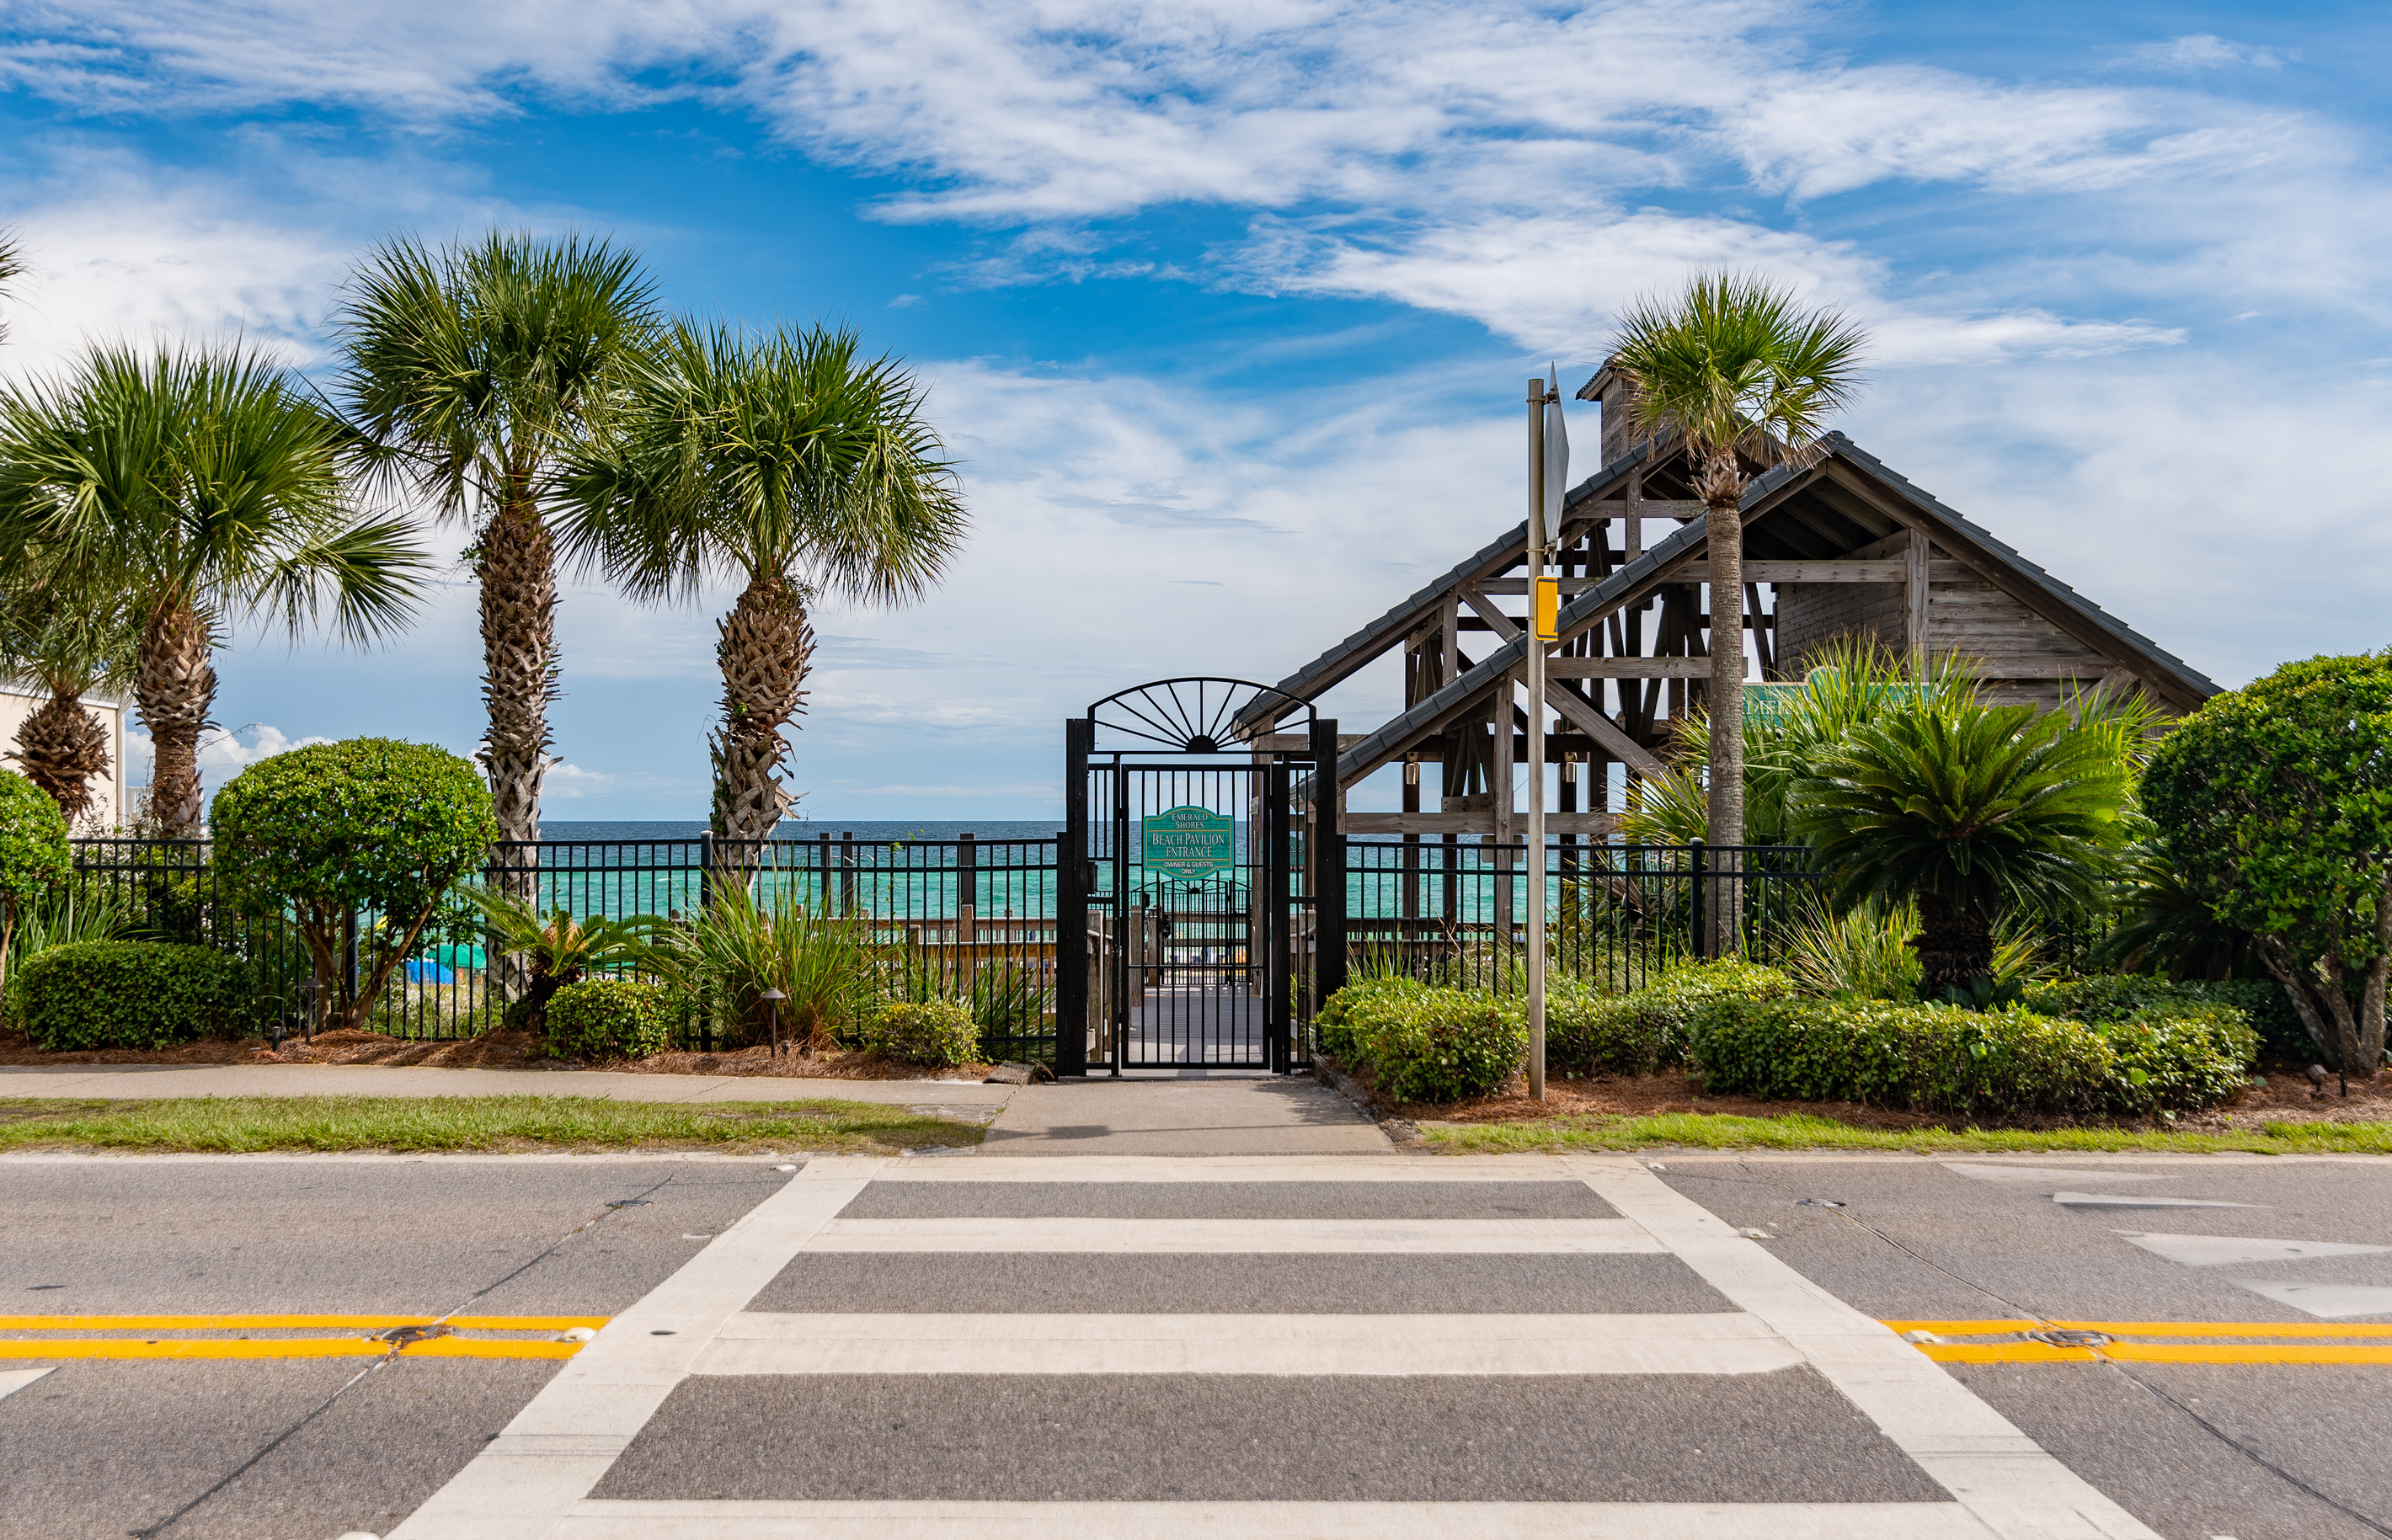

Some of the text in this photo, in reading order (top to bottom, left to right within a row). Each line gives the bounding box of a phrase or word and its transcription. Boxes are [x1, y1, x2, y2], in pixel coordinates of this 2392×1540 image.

[1152, 833, 1225, 845] BEACH PAVILION
[1166, 847, 1213, 857] ENTRANCE
